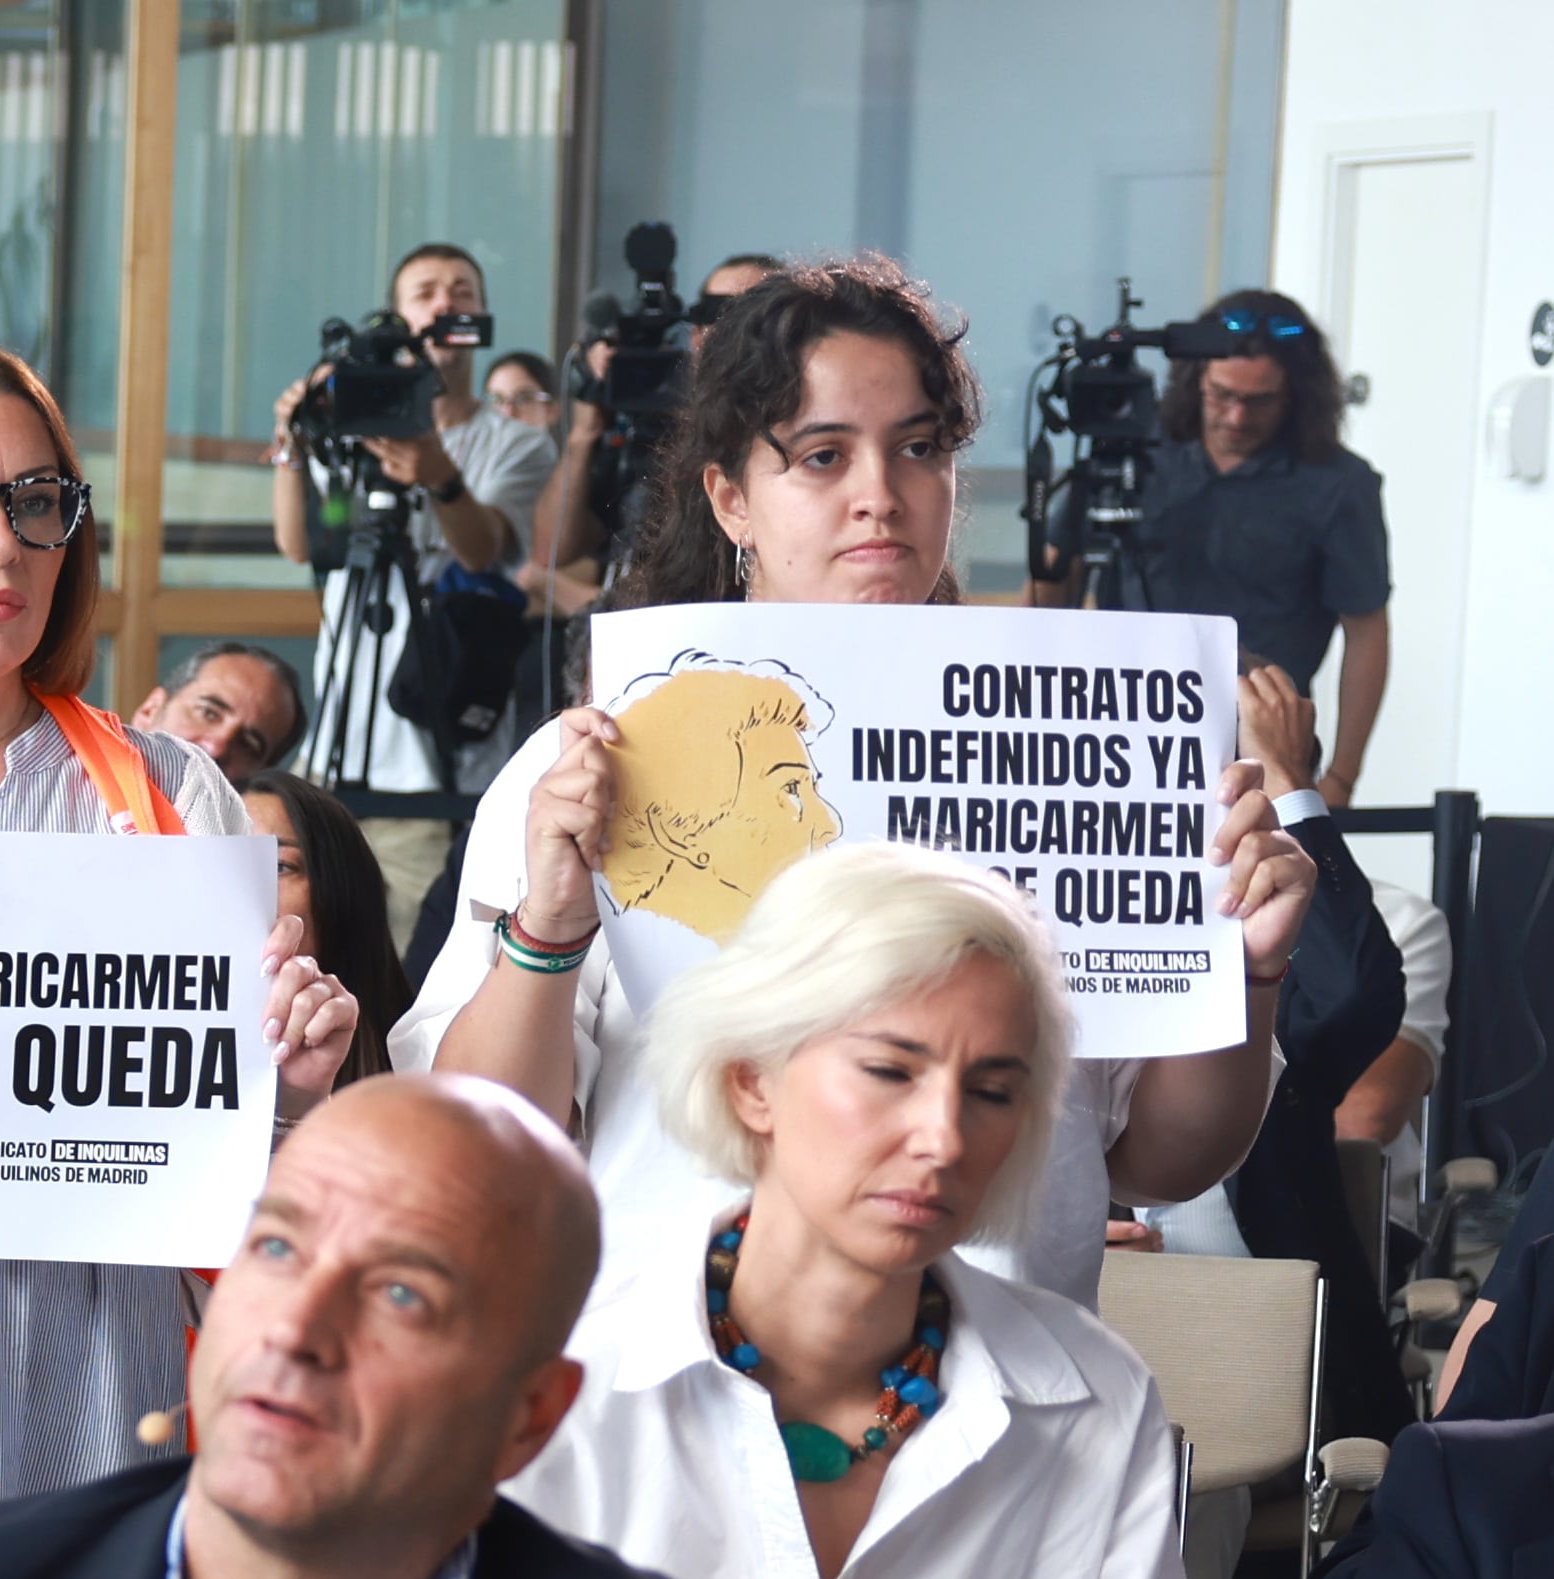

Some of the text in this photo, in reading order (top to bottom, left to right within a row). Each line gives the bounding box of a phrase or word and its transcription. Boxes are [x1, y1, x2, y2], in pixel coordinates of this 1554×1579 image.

[943, 663, 1203, 723] CONTRATOS
[852, 727, 1205, 789] INDEFINIDOS YA
[887, 795, 1203, 857] MARICARMEN
[1055, 868, 1203, 927] QUEDA
[1089, 952, 1114, 970] DE
[1114, 952, 1208, 972] INQUILINAS
[1102, 977, 1120, 992] DE
[1125, 977, 1190, 993] MADRID
[12, 1023, 238, 1113] QUEDA
[55, 1142, 76, 1160] DE
[77, 1143, 166, 1164] INQUILINAS
[65, 1166, 84, 1182] DE
[87, 1167, 147, 1184] MADRID
